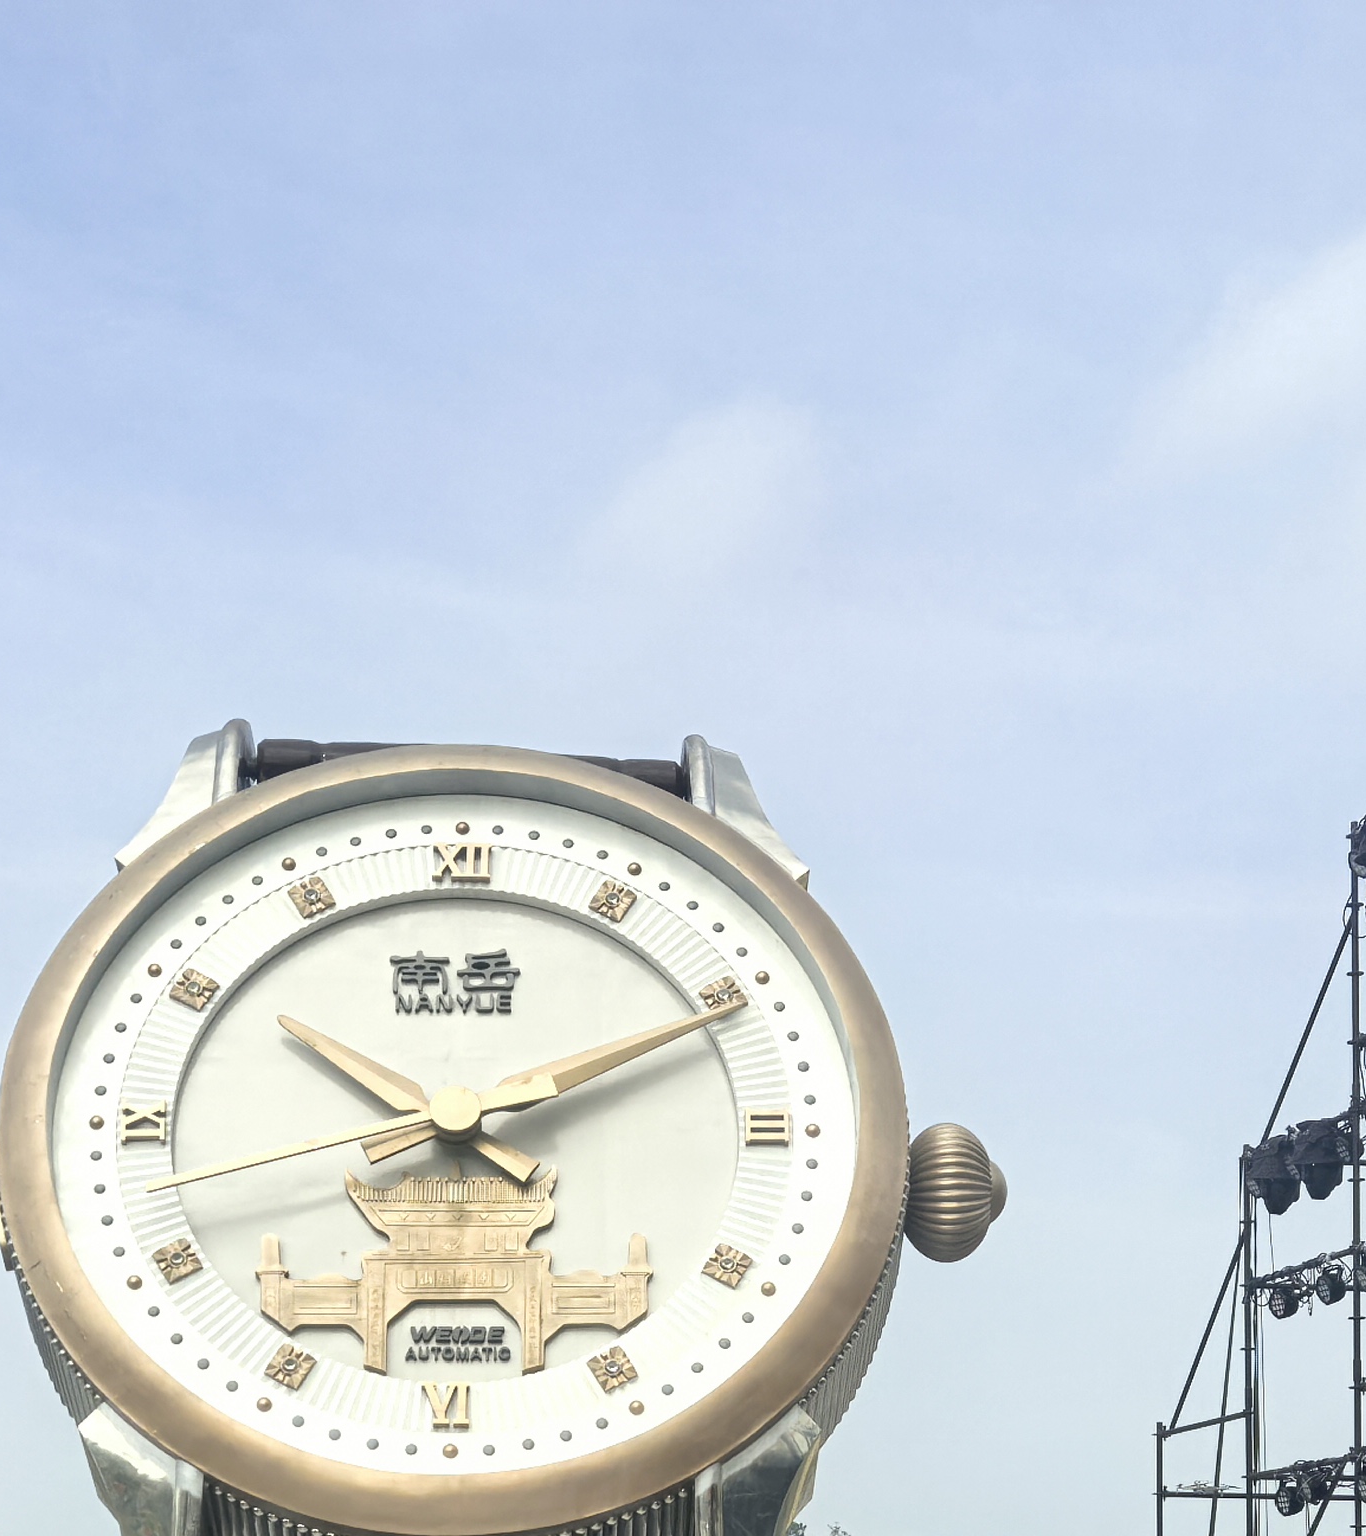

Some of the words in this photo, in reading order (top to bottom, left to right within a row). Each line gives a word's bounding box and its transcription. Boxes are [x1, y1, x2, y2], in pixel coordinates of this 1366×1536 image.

[431, 842, 492, 883] XII
[390, 948, 521, 995] 南岳
[395, 993, 512, 1015] NANYUE
[404, 1345, 512, 1363] AUTOMATIC
